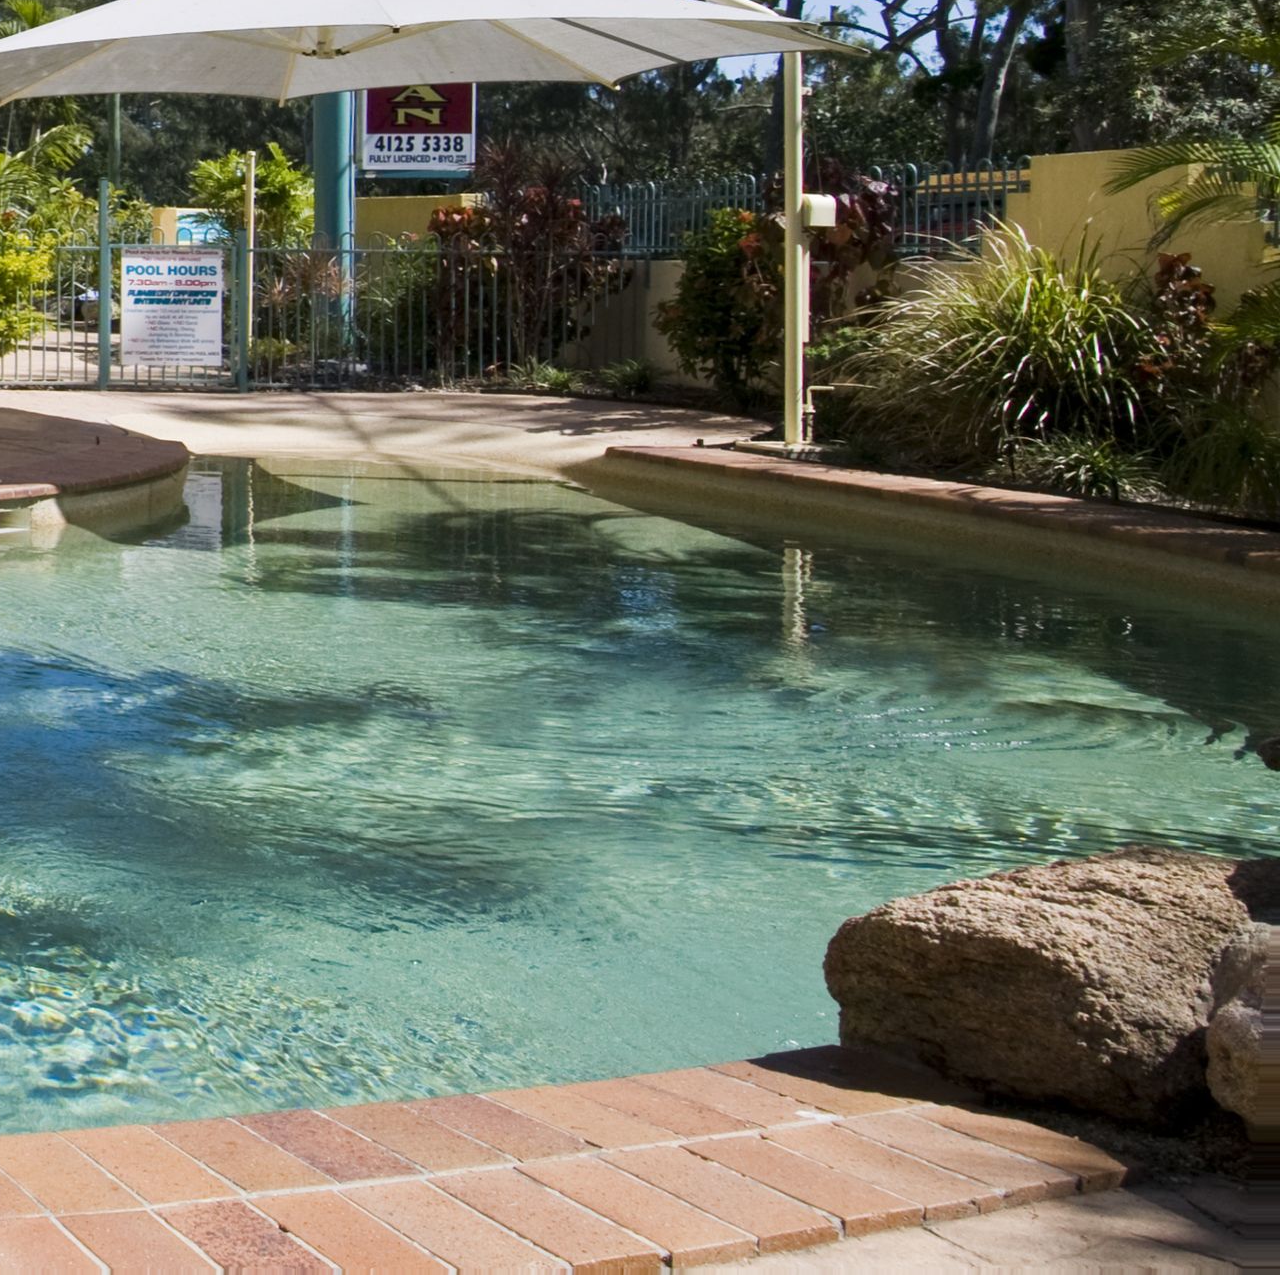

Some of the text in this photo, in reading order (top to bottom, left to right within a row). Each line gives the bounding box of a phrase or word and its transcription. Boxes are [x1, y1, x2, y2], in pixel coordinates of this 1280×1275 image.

[374, 136, 464, 152] 4125 5338
[369, 154, 392, 164] FULLY
[393, 154, 431, 164] LICENCED
[126, 265, 218, 276] POOL HOURS
